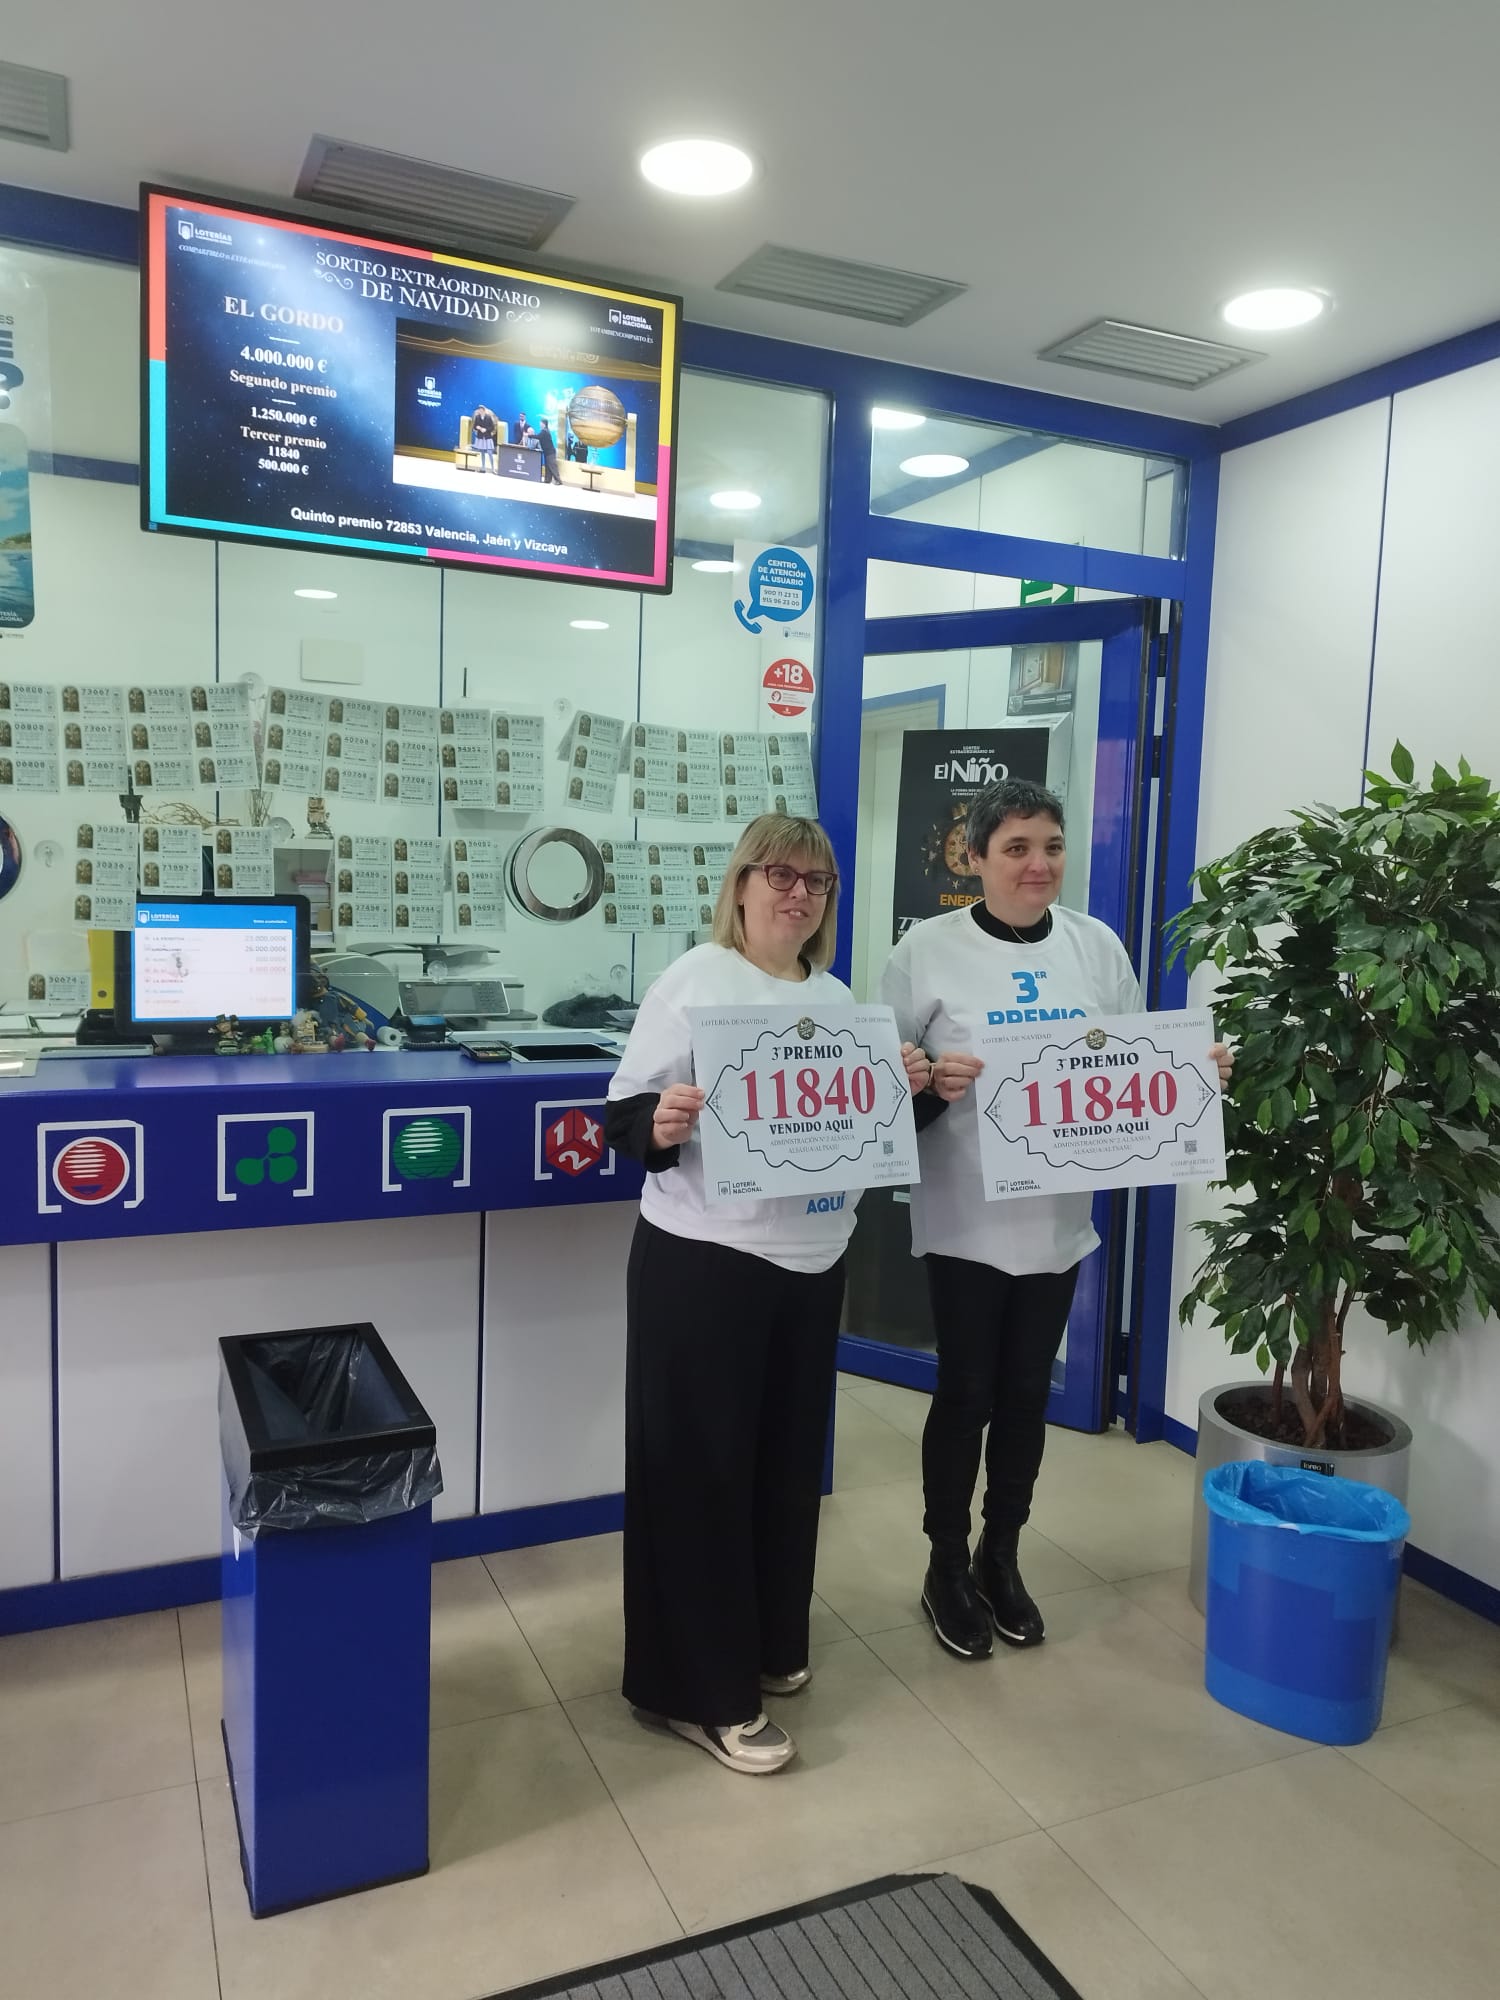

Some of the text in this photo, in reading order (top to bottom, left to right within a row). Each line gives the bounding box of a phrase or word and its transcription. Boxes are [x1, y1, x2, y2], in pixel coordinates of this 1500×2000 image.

[195, 228, 232, 242] LOTERÍAS
[315, 251, 540, 309] SORTEO EXTRAORDINARIO
[360, 278, 499, 322] DE NAVIDAD
[224, 295, 344, 334] EL GORDO
[622, 314, 647, 324] LOTERÍA
[622, 320, 653, 331] NACIONAL
[240, 346, 328, 373] 4.000.000 €
[229, 369, 337, 399] Segundo premio
[251, 406, 317, 427] 1.250.000 €
[240, 425, 327, 450] Tercer premio
[268, 446, 300, 460] 11840
[258, 458, 309, 475] 500.000 €
[291, 507, 568, 555] Quinto premio 72853 Valencia, Jaén y Vizcaya
[757, 566, 807, 578] DE ATENCIÓN
[767, 559, 798, 569] CENTRO
[760, 574, 804, 586] AL USUARIO
[773, 663, 803, 685] +18
[934, 757, 1009, 786] El Niño
[740, 1017, 769, 1025] NAVIDAD
[1021, 1033, 1052, 1041] NAVIDAD
[783, 1044, 843, 1060] PREMIO
[1069, 1052, 1140, 1071] PREMIO
[740, 1065, 876, 1121] 11840
[1021, 1070, 1178, 1128] 11840
[553, 1116, 600, 1149] 1 X
[769, 1118, 854, 1136] VENDIDO AQUÍ
[1052, 1118, 1150, 1139] VENDIDO AQUÍ
[558, 1150, 593, 1171] 2
[732, 1180, 757, 1189] LOTERÍA
[732, 1186, 763, 1194] NACIONAL
[1009, 1179, 1035, 1187] LOTERÍA
[1009, 1184, 1041, 1192] NACIONAL
[806, 1191, 847, 1215] AQUÍ
